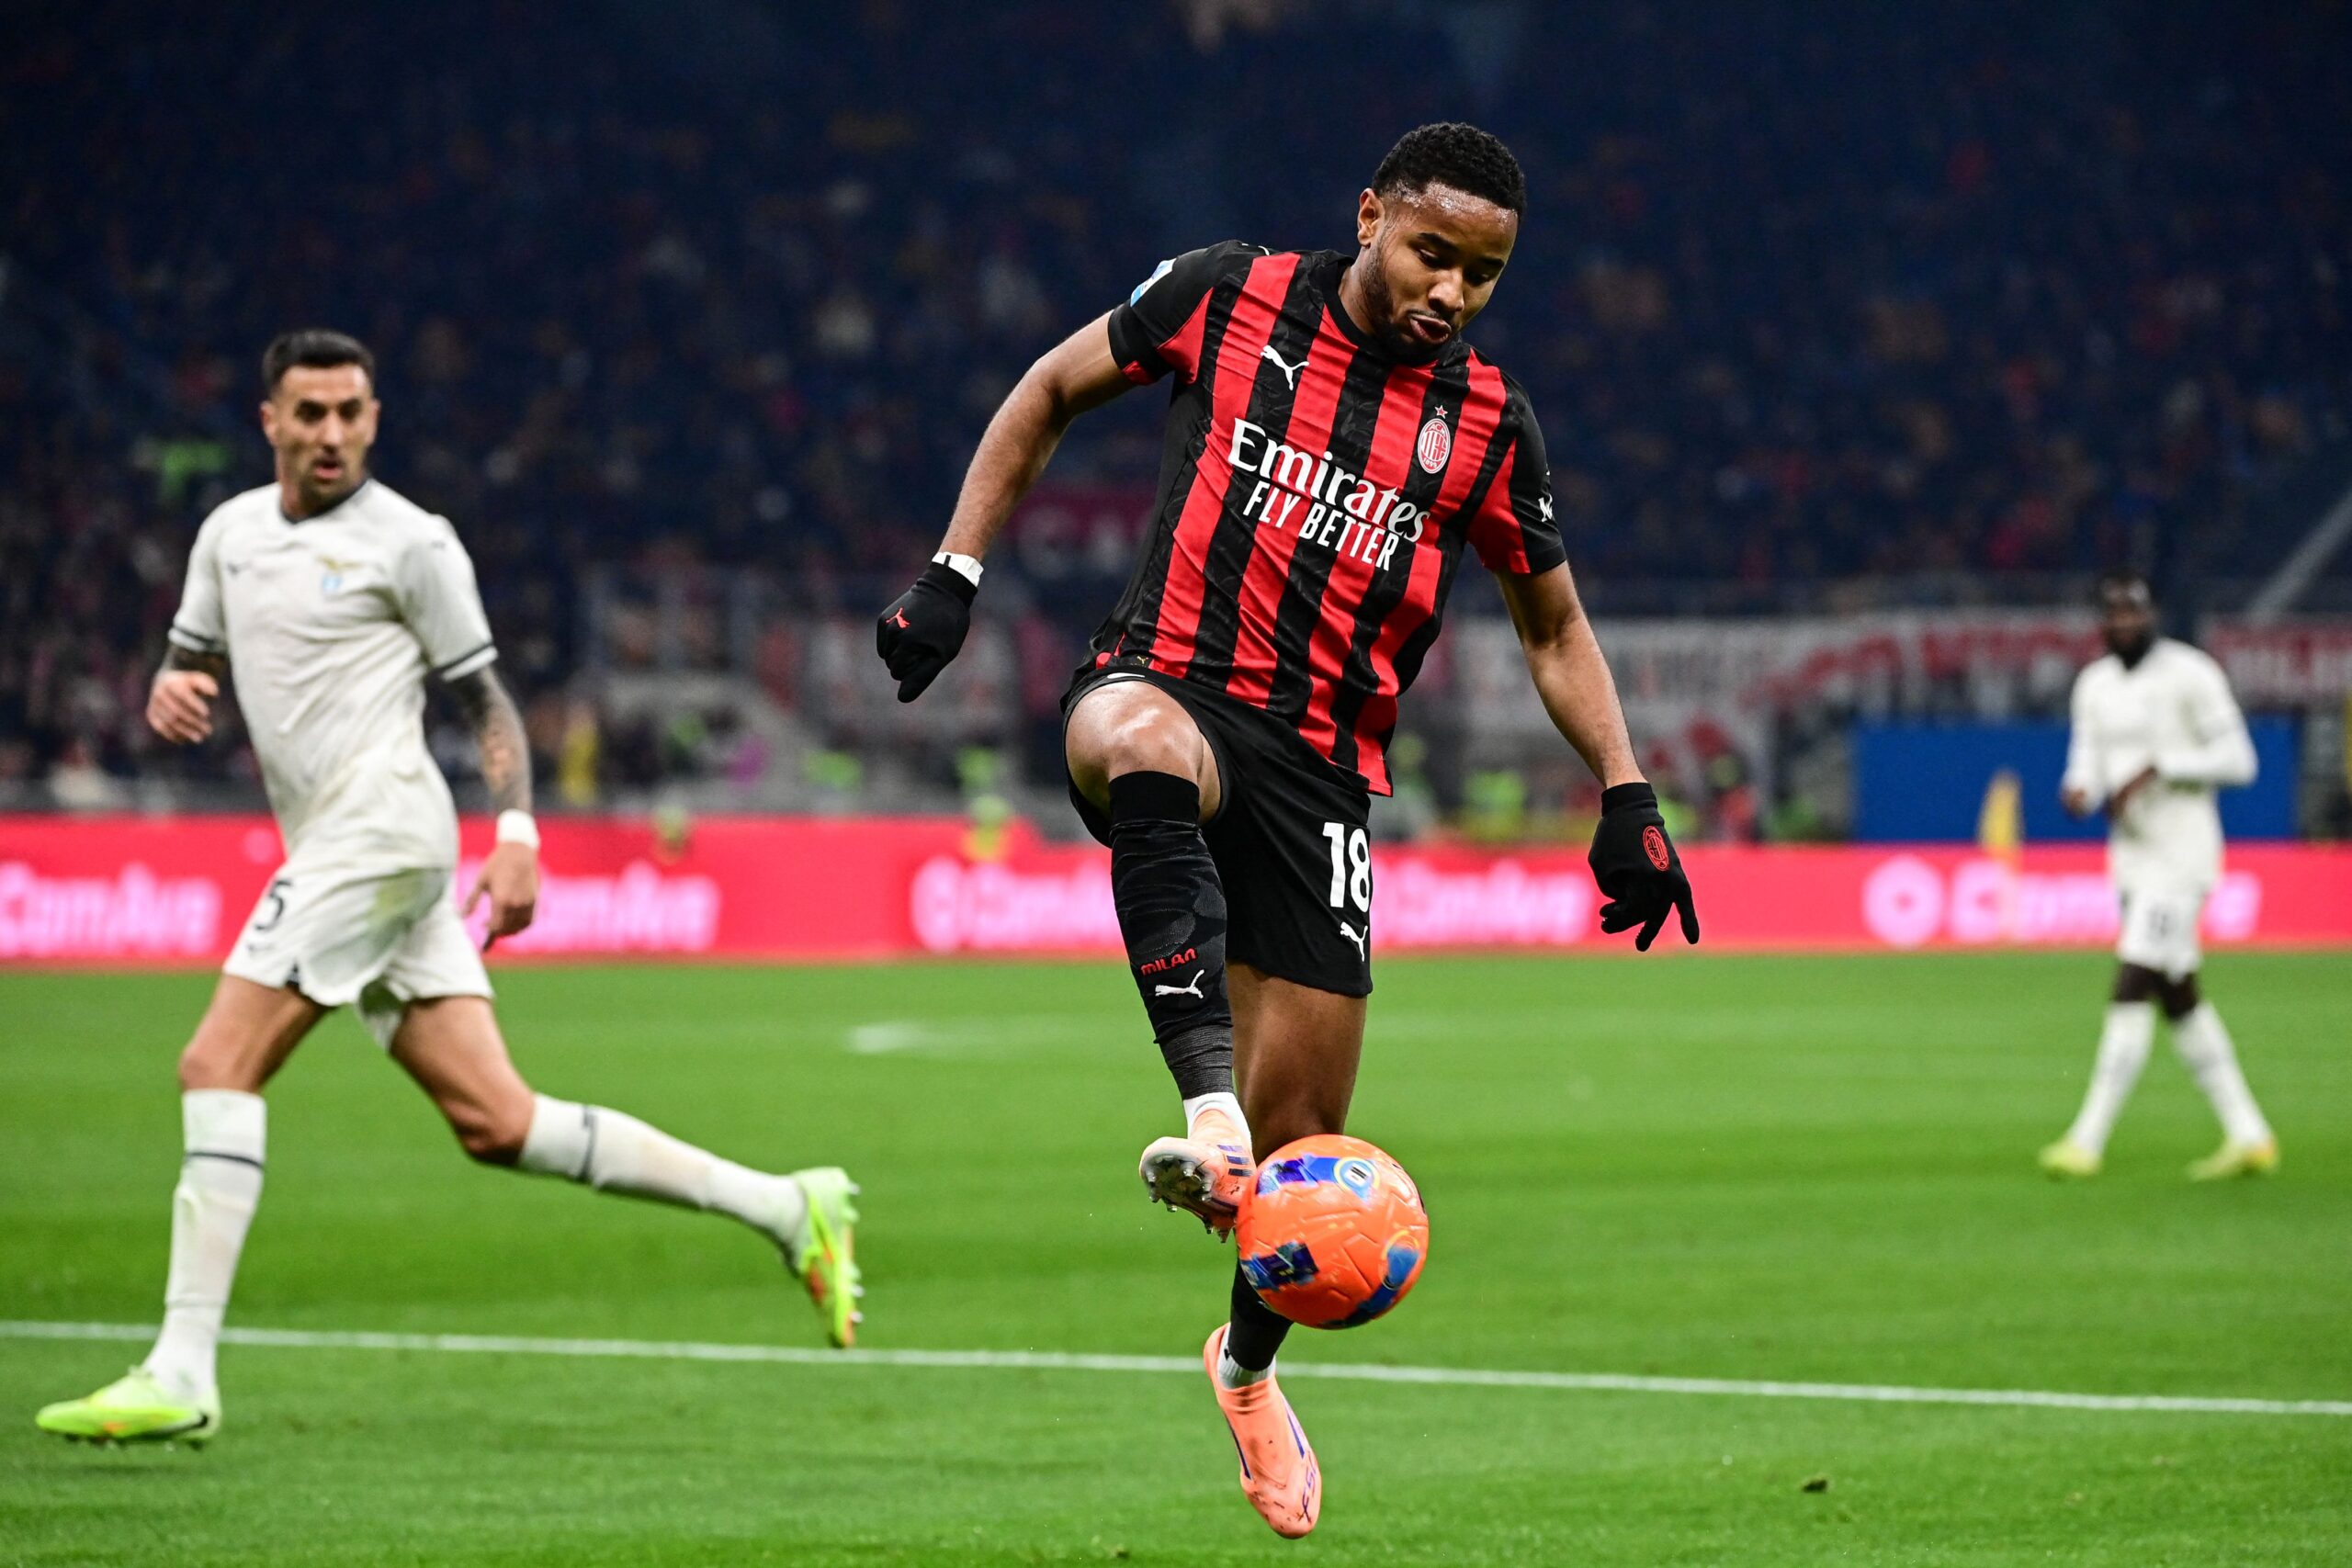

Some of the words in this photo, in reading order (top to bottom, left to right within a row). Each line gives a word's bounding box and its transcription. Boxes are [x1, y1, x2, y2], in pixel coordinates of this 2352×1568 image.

[1227, 417, 1431, 544] Emirates
[1242, 479, 1302, 529] FLY
[1298, 502, 1400, 571] BETTER
[1322, 821, 1371, 913] 18
